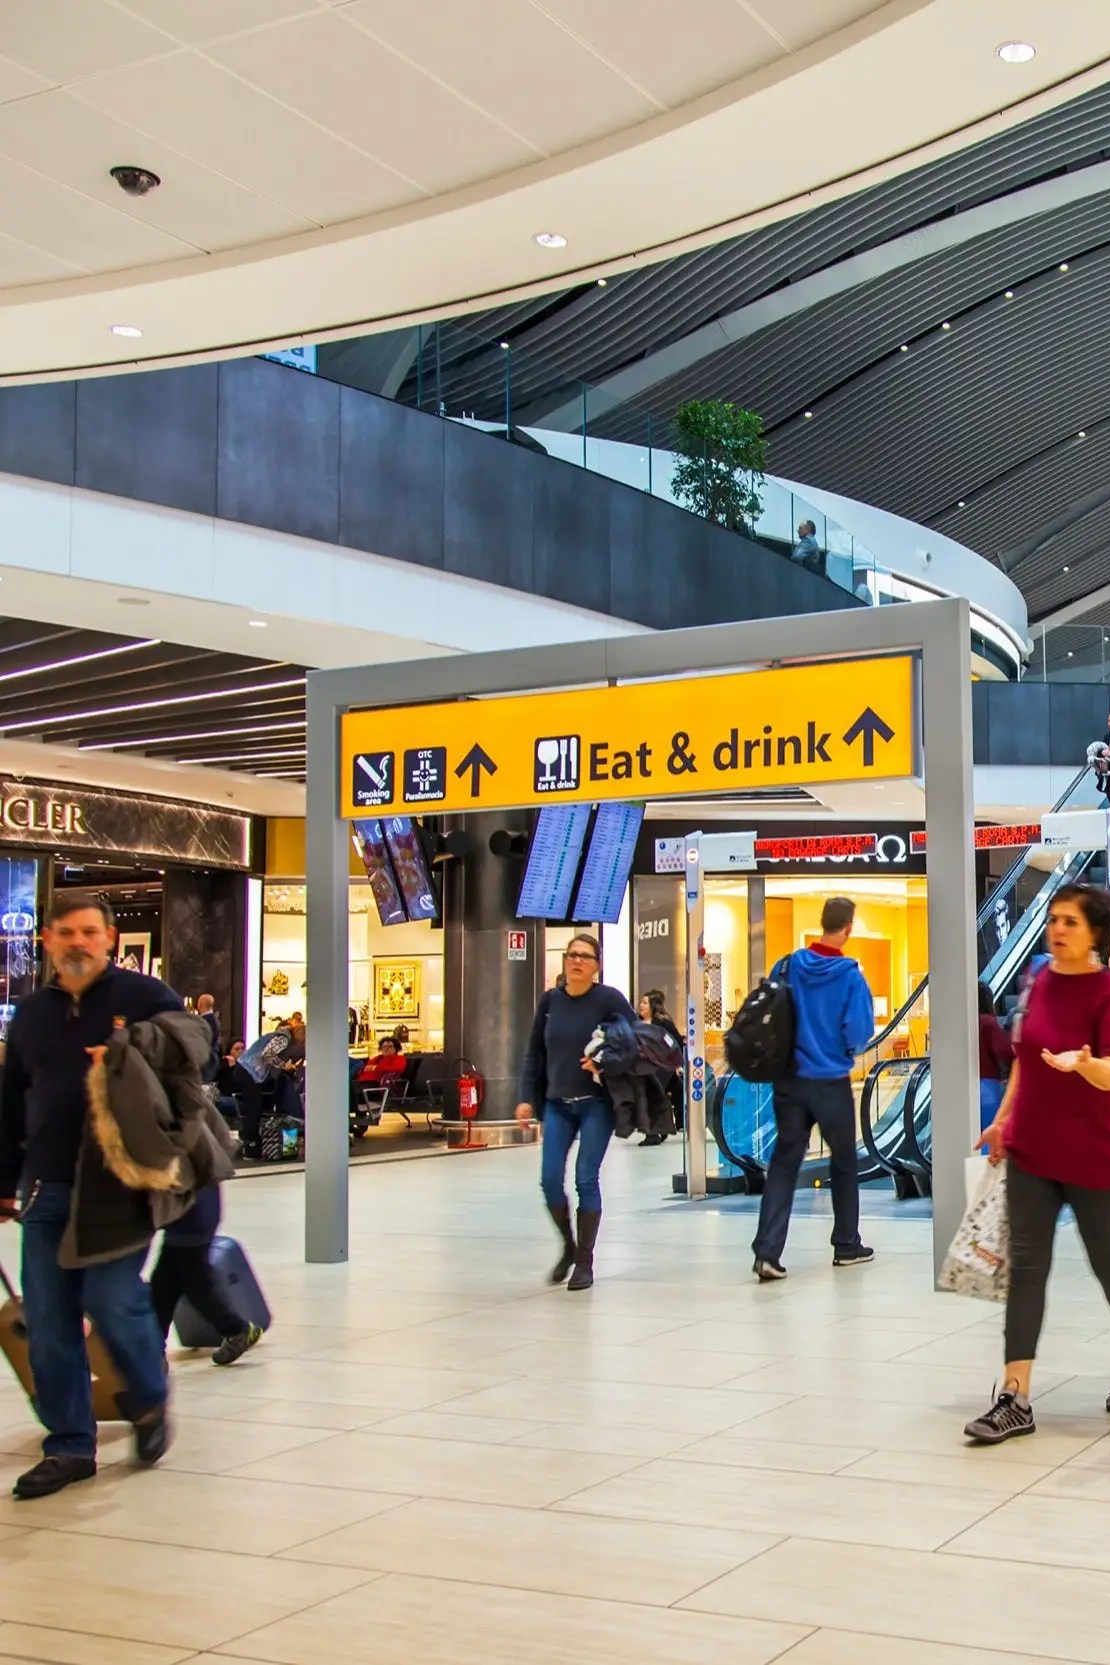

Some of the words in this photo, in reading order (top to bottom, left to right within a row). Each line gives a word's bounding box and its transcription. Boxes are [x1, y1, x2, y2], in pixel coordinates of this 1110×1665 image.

[418, 750, 432, 759] OTC
[589, 742, 652, 781] Eat
[667, 731, 698, 775] &
[713, 721, 832, 771] drink
[537, 781, 549, 790] Eat
[550, 780, 556, 790] &
[557, 780, 576, 789] drink
[357, 789, 390, 800] Smoking
[405, 790, 444, 801] Parafarmacia
